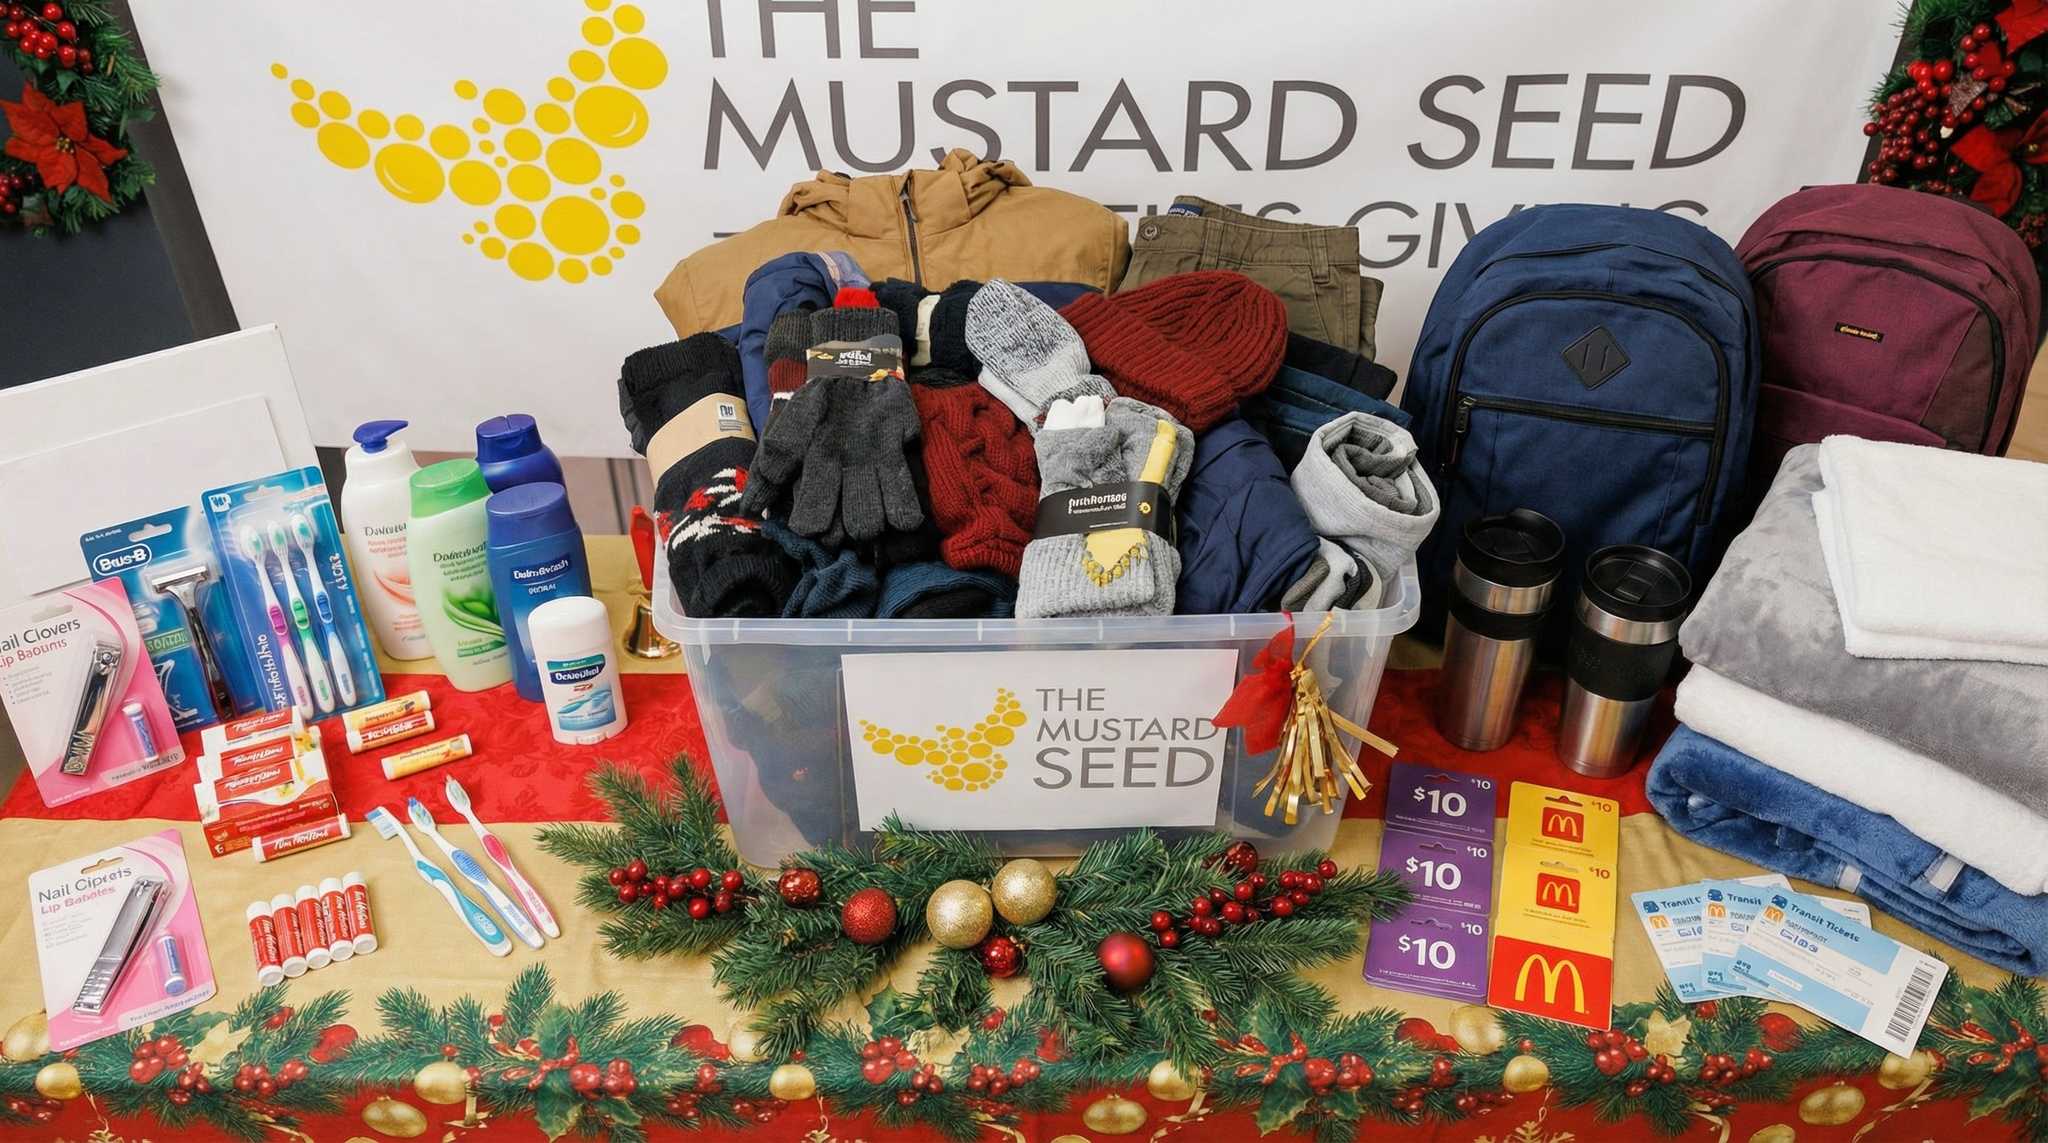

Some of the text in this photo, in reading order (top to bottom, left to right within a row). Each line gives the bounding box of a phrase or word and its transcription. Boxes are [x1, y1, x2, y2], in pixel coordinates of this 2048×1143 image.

[703, 73, 1747, 173] MUSTARD SEED
[0, 619, 81, 653] ail Clovers
[1035, 688, 1105, 711] THE
[1036, 718, 1219, 742] MUSTARD
[1032, 747, 1215, 790] SEED
[1413, 786, 1467, 817] $10
[1405, 856, 1462, 890] $10
[38, 884, 70, 904] Nail
[1791, 903, 1824, 925] Transit
[1398, 934, 1456, 969] $10
